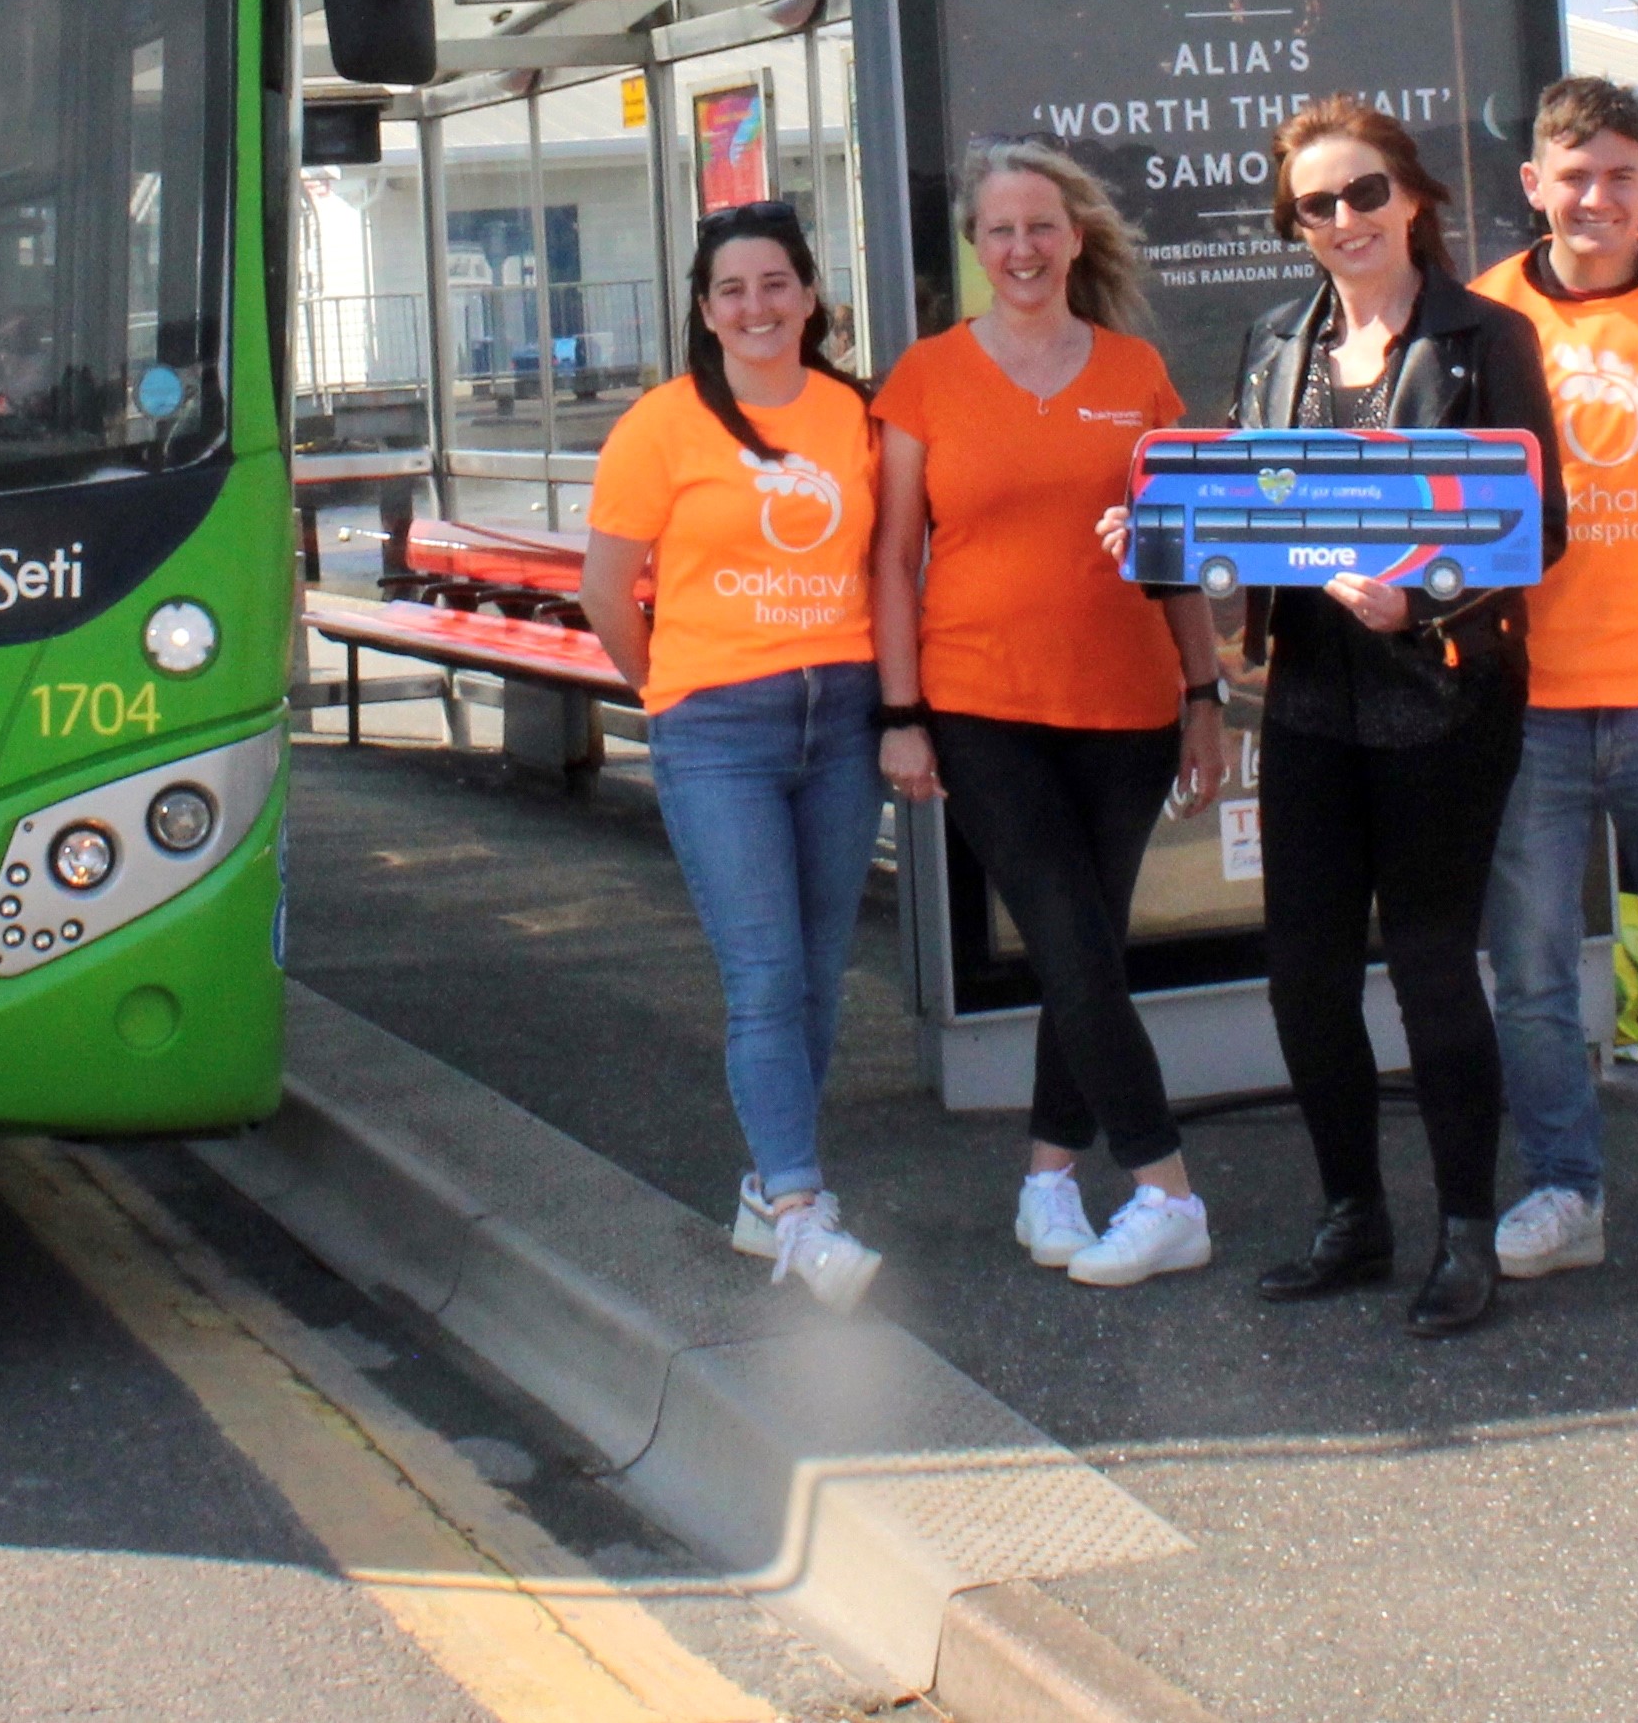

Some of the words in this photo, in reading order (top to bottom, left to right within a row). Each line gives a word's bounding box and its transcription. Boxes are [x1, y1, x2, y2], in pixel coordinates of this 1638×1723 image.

[1173, 39, 1311, 76] ALIA'S
[1033, 96, 1210, 137] 'WORTH
[1348, 88, 1451, 122] AIT'
[1145, 150, 1269, 190] SAMO
[1143, 241, 1246, 261] INGREDIENTS
[1250, 239, 1282, 257] FOR
[1161, 271, 1195, 287] THIS
[1200, 266, 1277, 284] RAMADAN
[1282, 264, 1315, 279] AND
[1288, 547, 1357, 566] more
[714, 566, 857, 597] Oakhav
[30, 681, 163, 737] 1704
